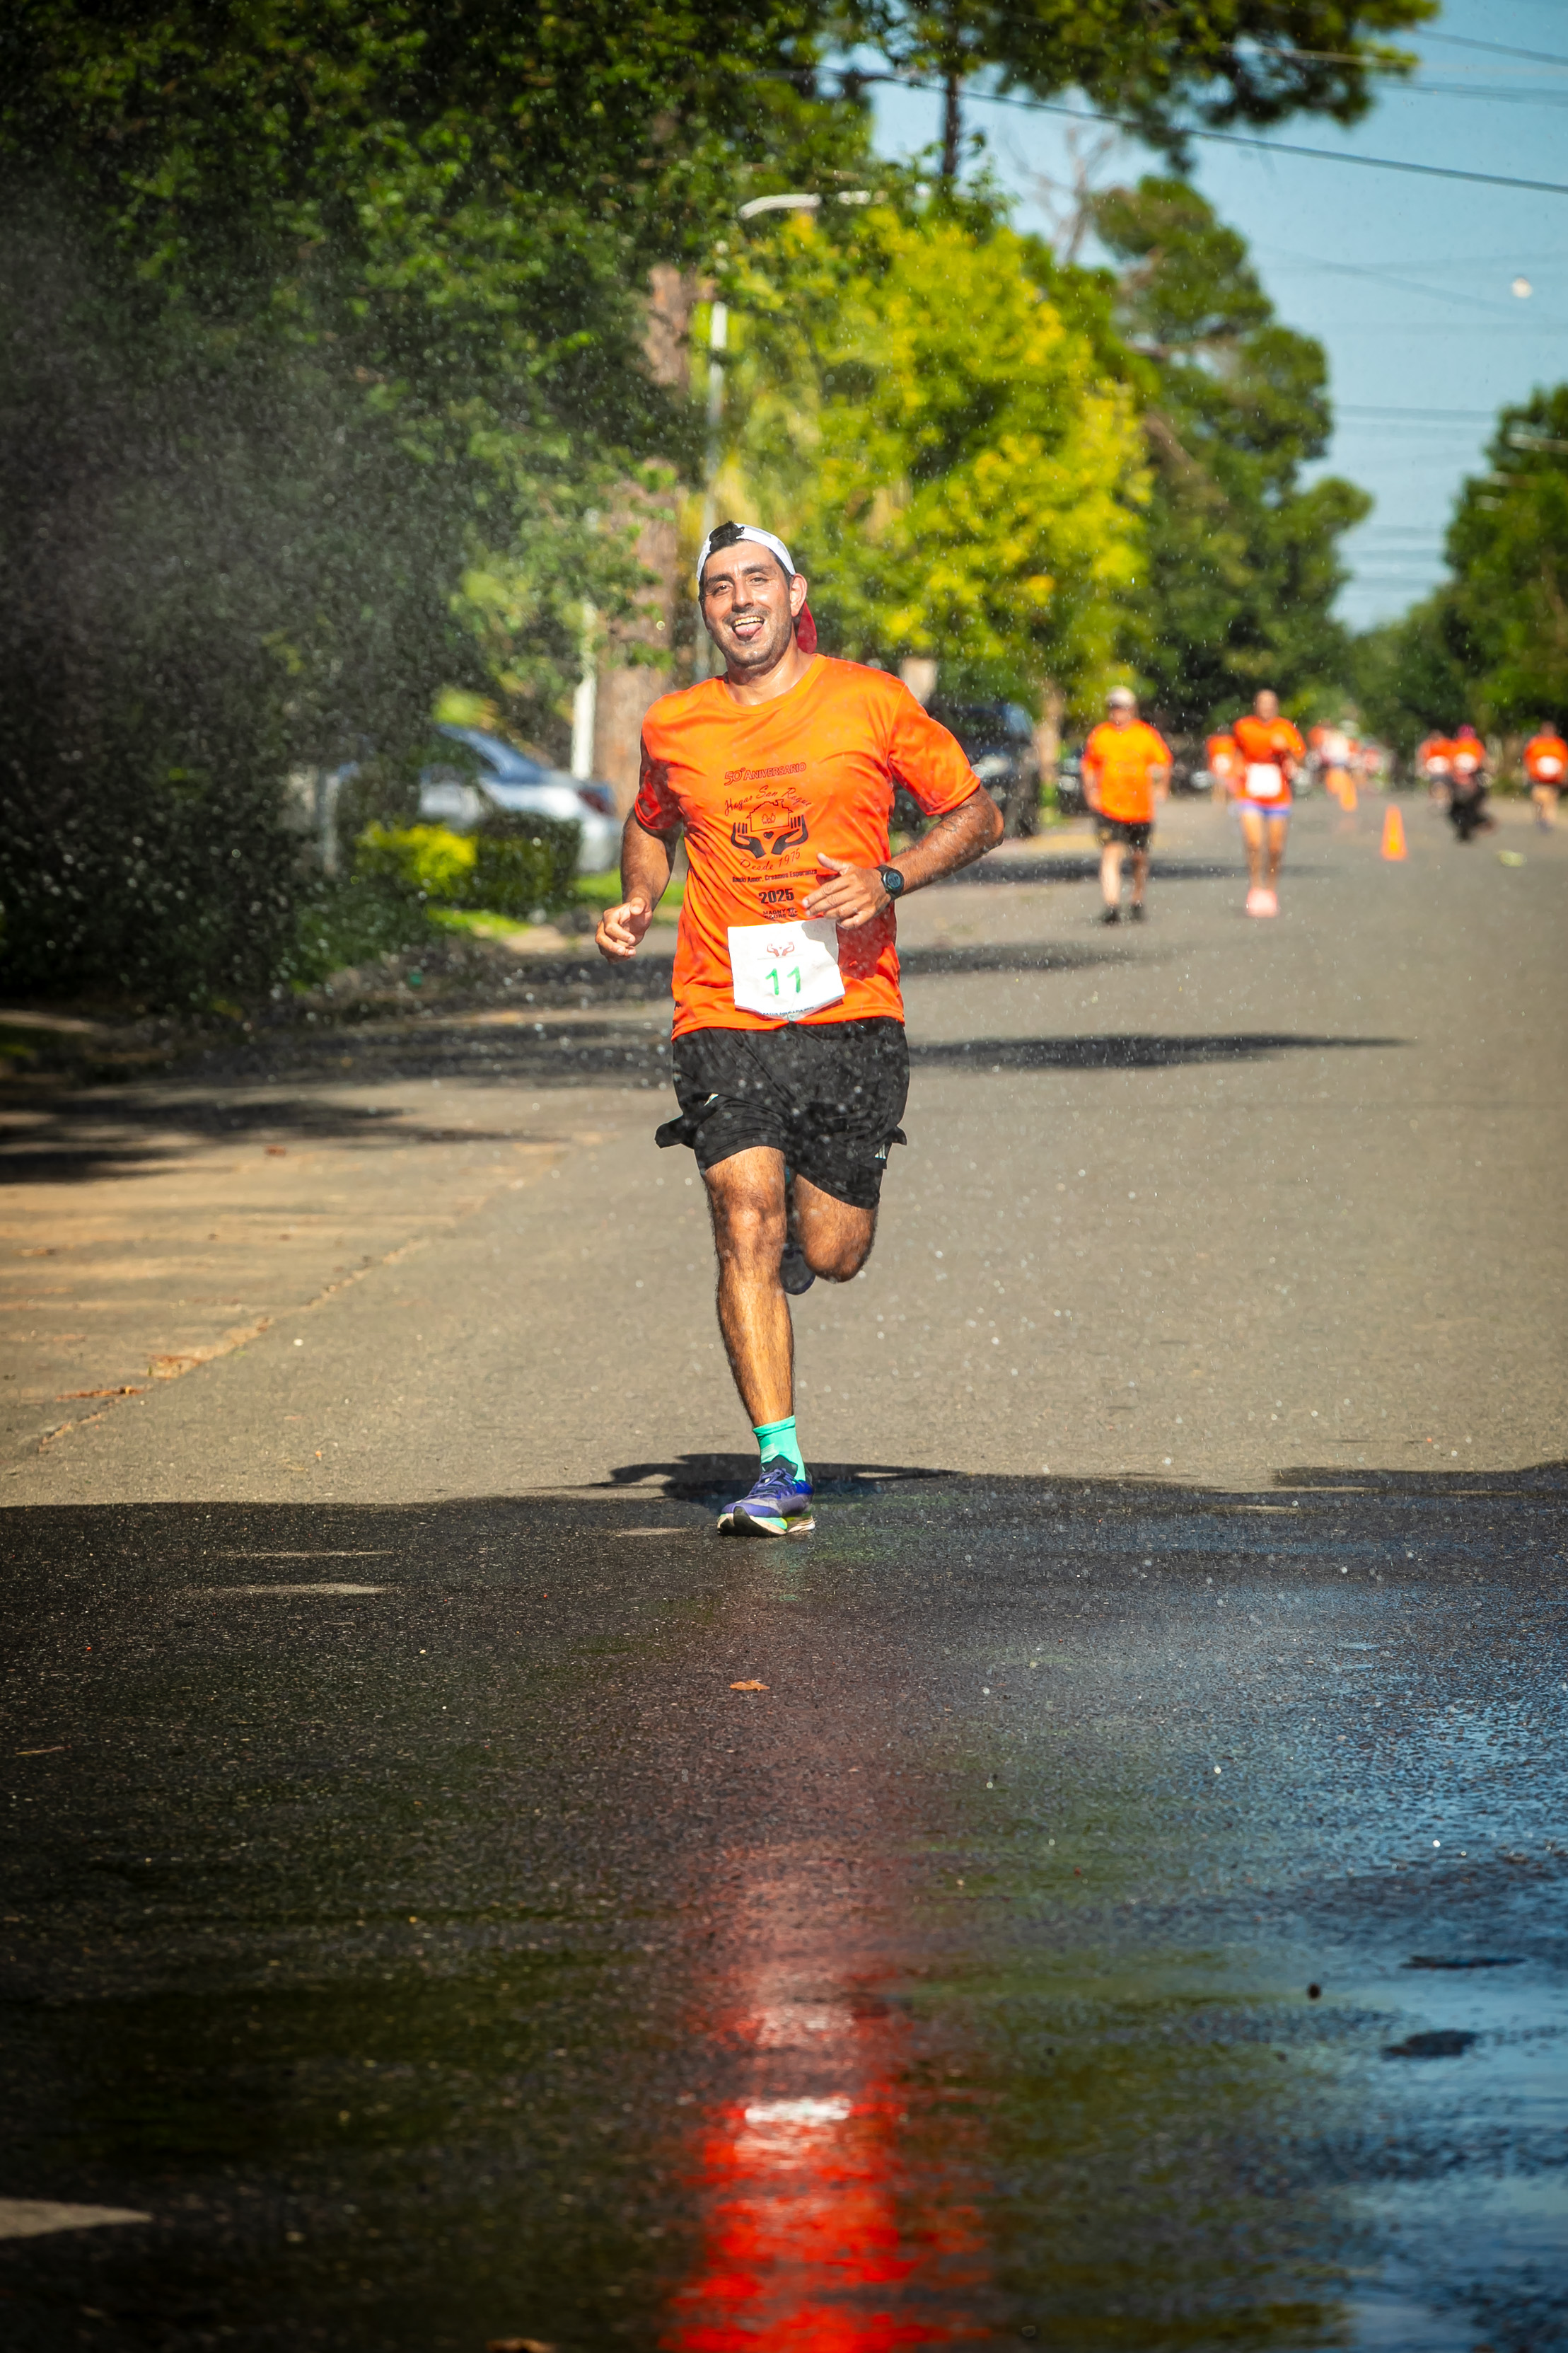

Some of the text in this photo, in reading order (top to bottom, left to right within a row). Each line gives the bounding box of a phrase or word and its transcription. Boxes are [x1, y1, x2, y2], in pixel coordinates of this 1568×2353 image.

[725, 785, 812, 816] Hogar San Roque
[740, 848, 801, 871] Desde 1975
[765, 872, 789, 881] Creamos
[789, 869, 818, 878] Esperanza
[758, 888, 794, 904] 2025
[765, 966, 801, 995] 11
